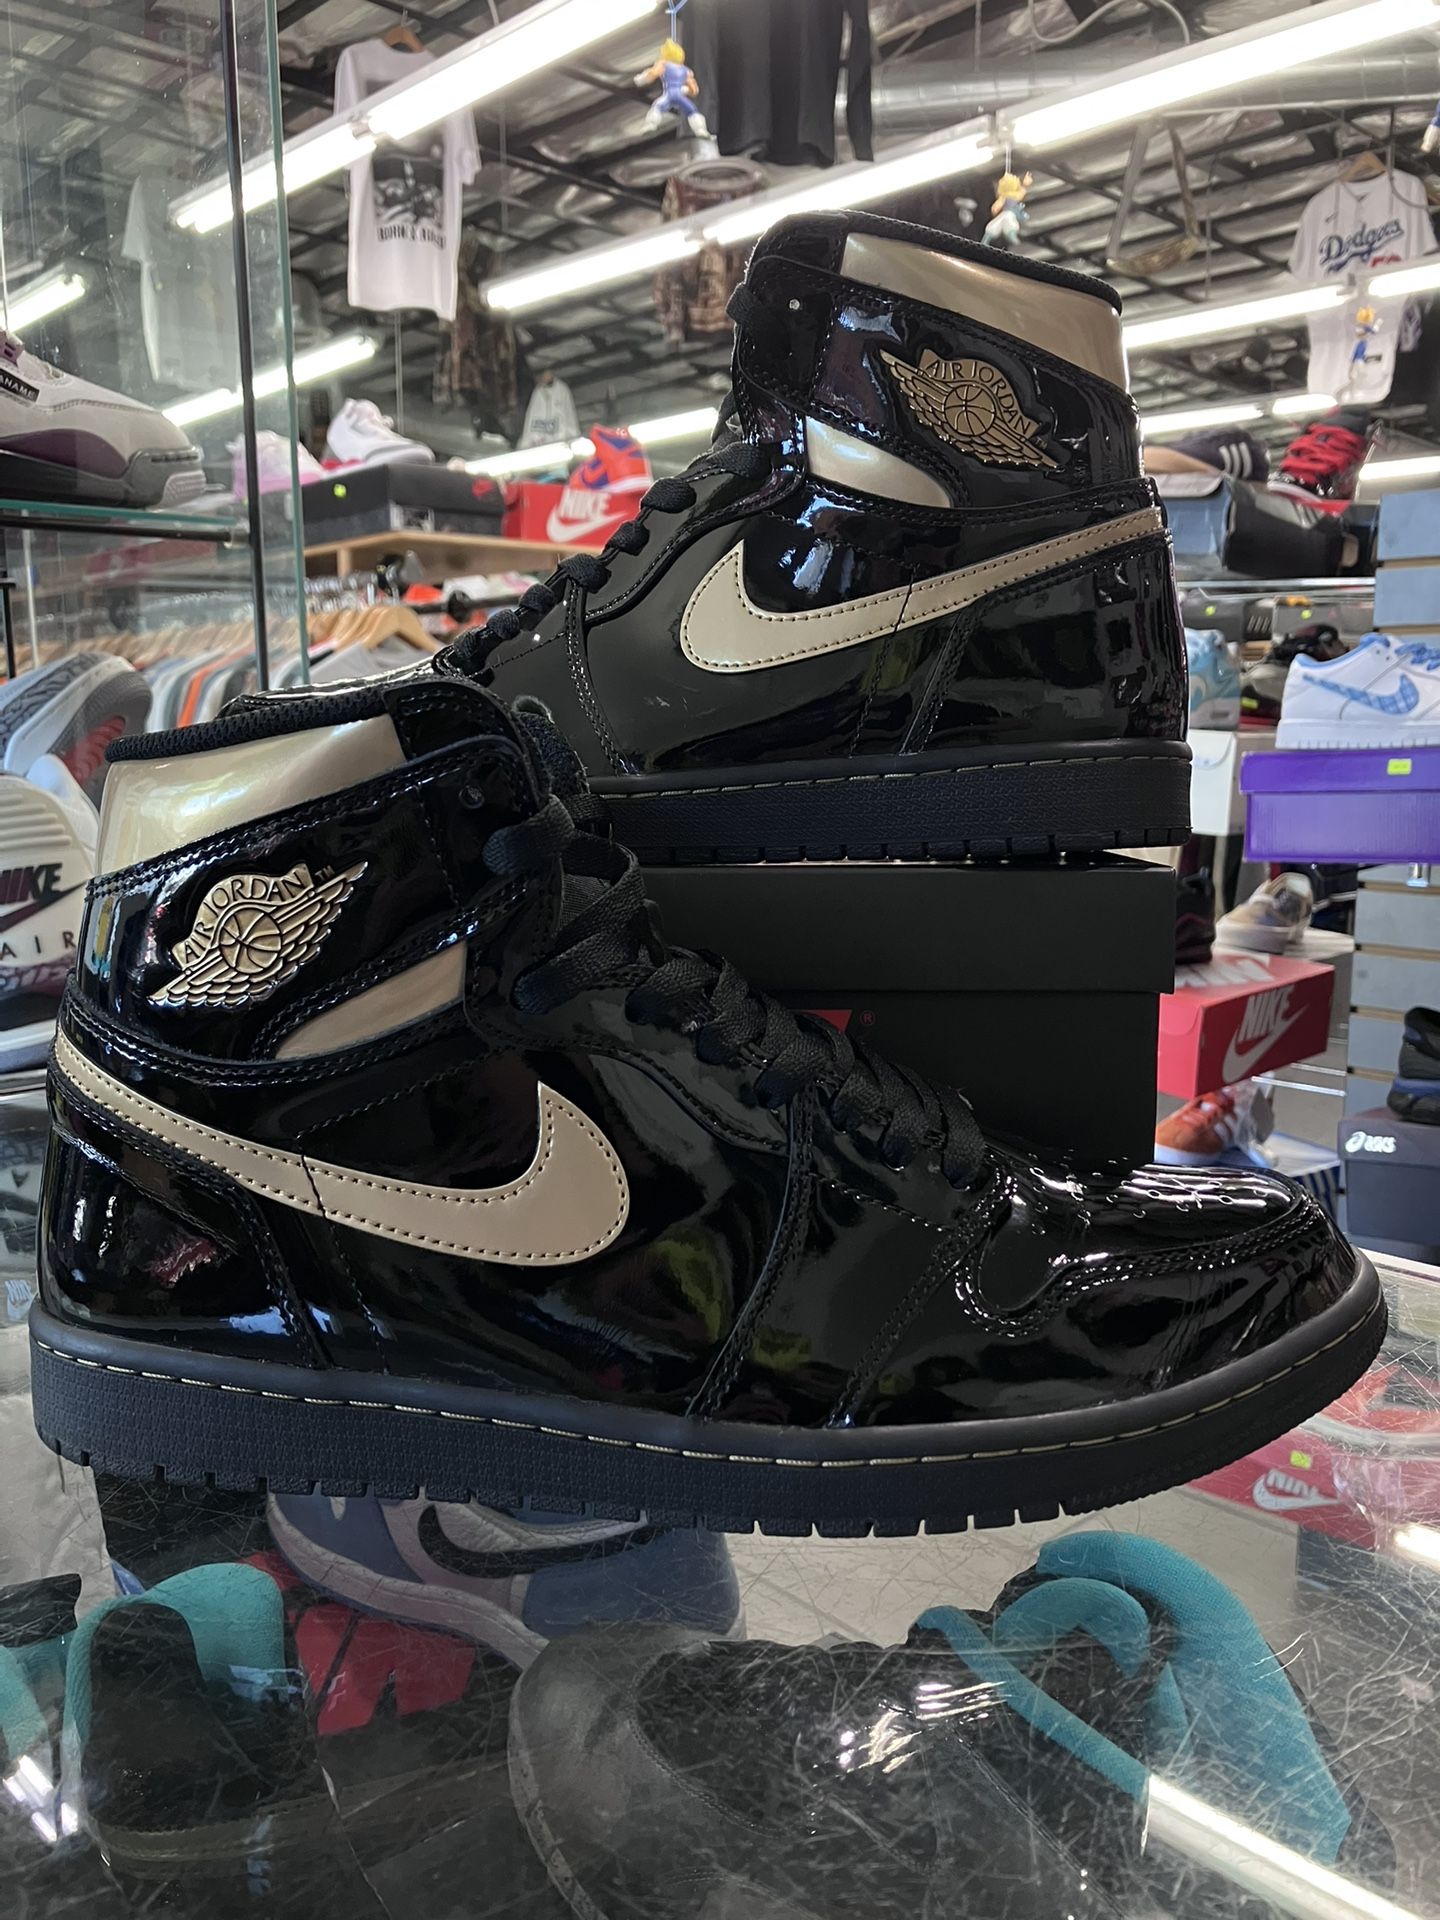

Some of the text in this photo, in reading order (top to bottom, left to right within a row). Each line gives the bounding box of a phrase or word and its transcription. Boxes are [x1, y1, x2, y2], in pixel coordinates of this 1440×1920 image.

[1319, 218, 1405, 270] Dodgers
[925, 359, 1032, 435] AIR JORDAN
[558, 486, 613, 519] NIKE
[184, 869, 308, 965] AIR JORDAN
[0, 930, 77, 962] AIR
[1236, 984, 1296, 1045] NIKE
[1265, 1467, 1319, 1500] NIKE
